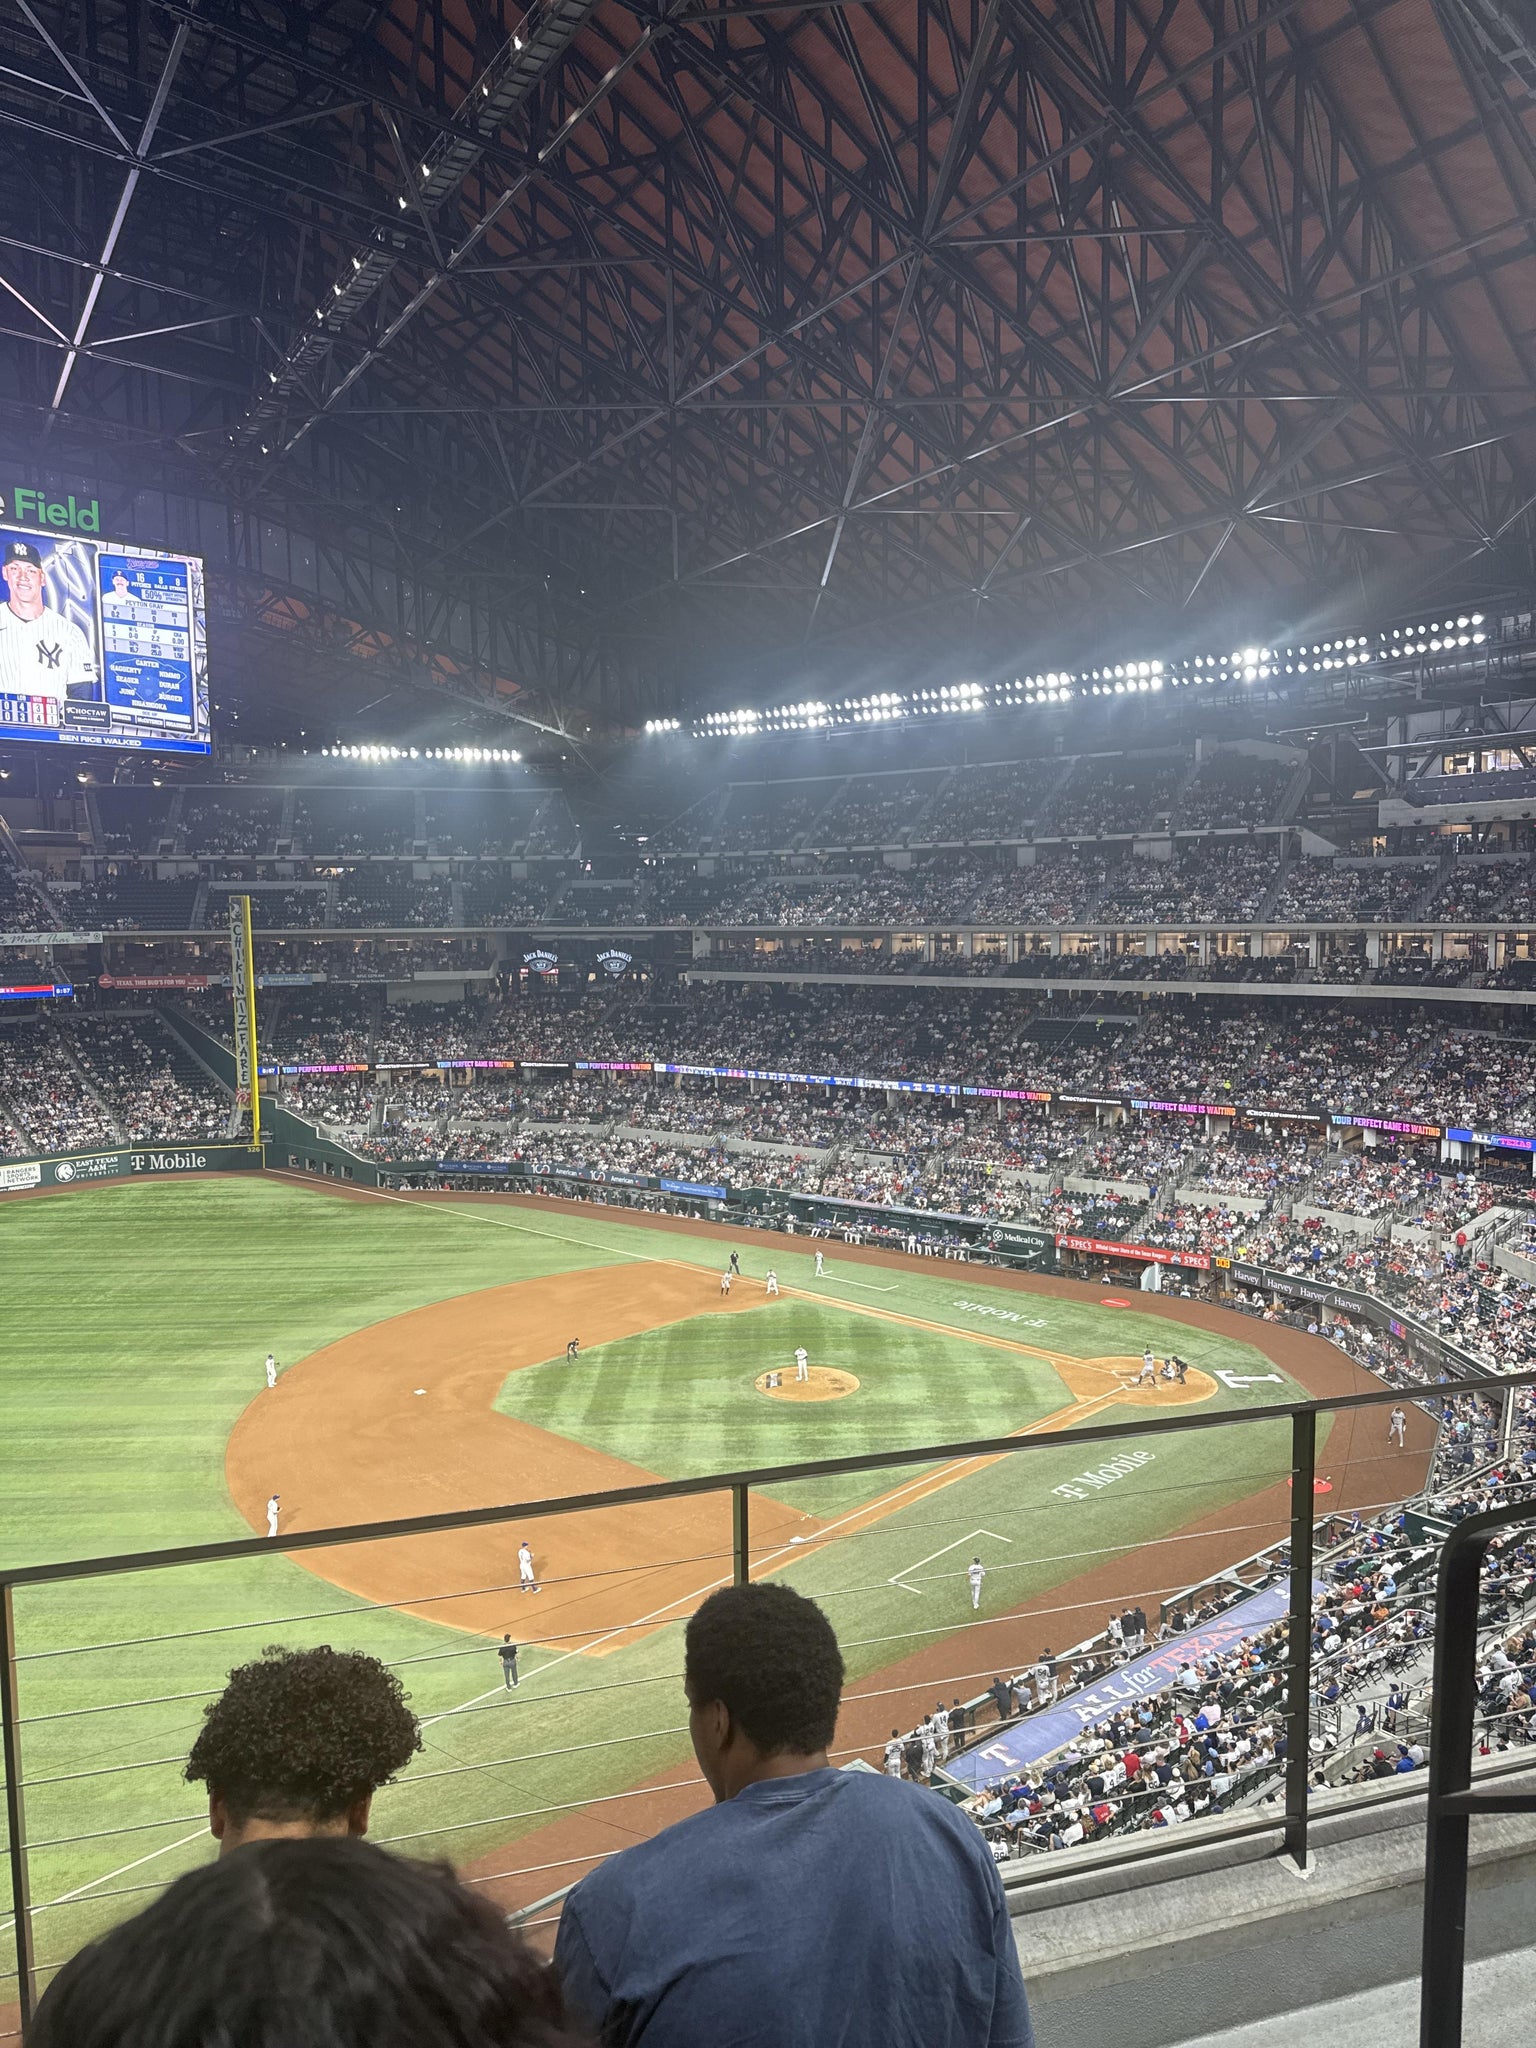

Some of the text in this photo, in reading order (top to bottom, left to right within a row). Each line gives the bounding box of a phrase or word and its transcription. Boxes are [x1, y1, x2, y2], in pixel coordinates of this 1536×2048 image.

[14, 487, 100, 532] Field
[144, 590, 162, 600] 50%
[69, 706, 107, 717] CHOCTAW
[59, 733, 142, 746] BEN RICE WALKED
[523, 951, 537, 963] JACK
[596, 951, 611, 963] JACK
[962, 1087, 978, 1095] YOUR
[978, 1088, 1002, 1097] PERFECT
[1002, 1090, 1019, 1098] GAME
[1019, 1091, 1026, 1100] IS
[1026, 1092, 1052, 1101] WAITING
[1130, 1100, 1148, 1109] YOUR
[1150, 1100, 1178, 1112] PERFECT
[1178, 1103, 1198, 1113] GAME
[1198, 1104, 1206, 1114] IS
[1206, 1105, 1236, 1116] WAITING
[1331, 1114, 1352, 1126] YOUR
[1352, 1117, 1382, 1129] PERFECT
[1383, 1120, 1402, 1132] GAME
[1402, 1123, 1410, 1133] IS
[1411, 1124, 1441, 1137] WAITING
[1471, 1133, 1490, 1144] ALL
[1500, 1138, 1532, 1149] TEXAS
[247, 1146, 260, 1154] 326
[76, 1156, 118, 1168] EAST TEXAS
[149, 1152, 207, 1170] Mobile
[6, 1166, 36, 1174] RANGERS
[76, 1169, 119, 1179] UNIVERSITY
[88, 1164, 107, 1173] A&M
[556, 1168, 578, 1176] American
[8, 1176, 40, 1184] NETWORK
[610, 1176, 634, 1184] American
[1004, 1232, 1045, 1248] Medical City
[1070, 1239, 1092, 1250] SPEC'S
[1184, 1256, 1209, 1267] SPEC'S
[1234, 1270, 1259, 1284] Harvey
[1267, 1278, 1294, 1294] Harvey
[1300, 1286, 1328, 1303] Harvey
[1334, 1296, 1362, 1312] Harvey
[953, 1300, 1028, 1322] Mobile
[1212, 1368, 1286, 1388] T
[1071, 1450, 1156, 1490] Mobile
[1068, 1621, 1244, 1723] ALL for TEXAS
[939, 1716, 947, 1724] 14
[925, 1727, 934, 1736] 24
[978, 1743, 1021, 1768] T
